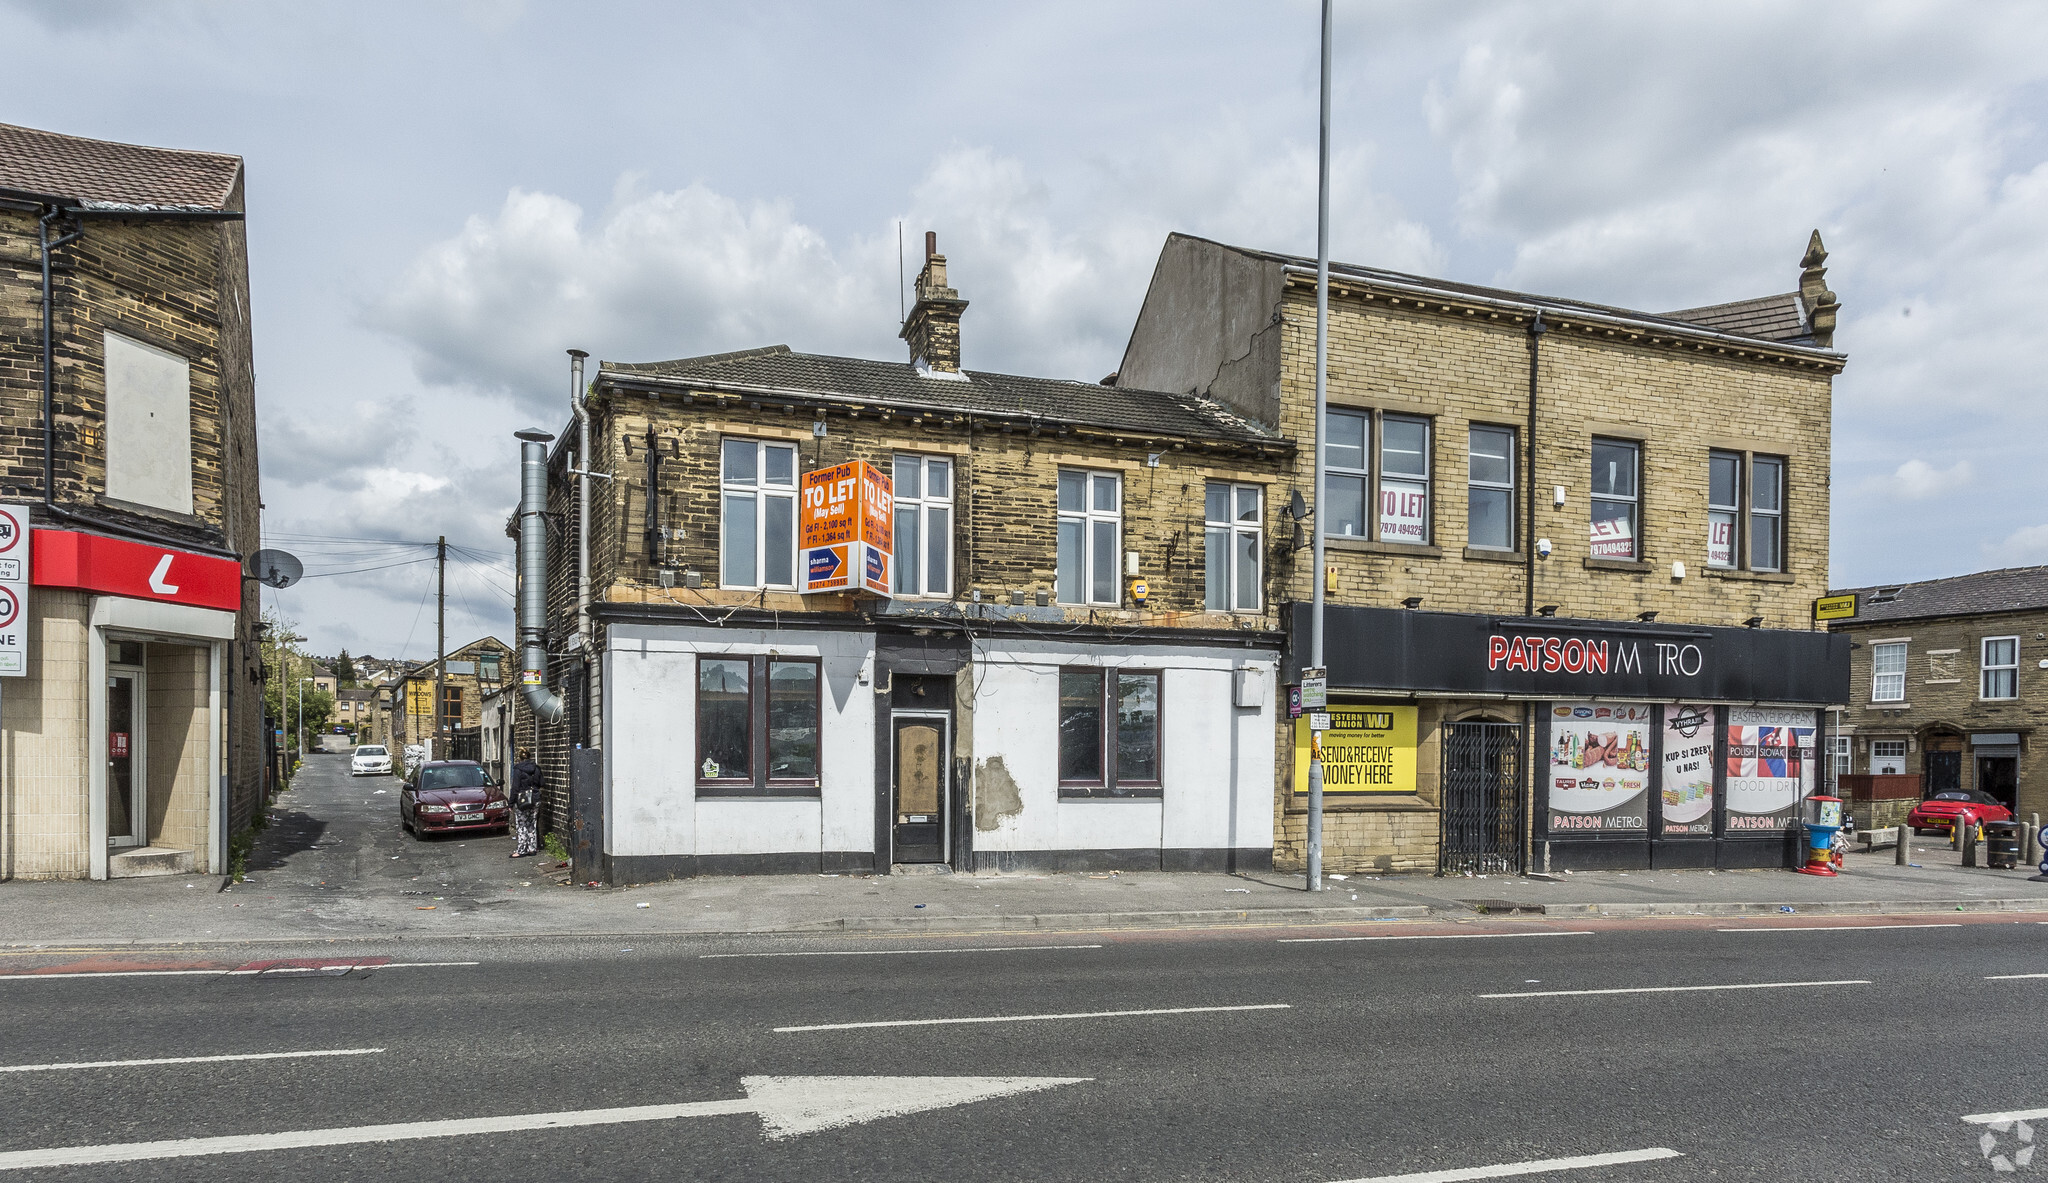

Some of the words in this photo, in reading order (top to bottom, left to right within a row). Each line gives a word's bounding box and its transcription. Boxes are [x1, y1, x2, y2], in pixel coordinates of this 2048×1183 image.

[810, 471, 834, 485] Former
[836, 465, 851, 479] Pub
[805, 485, 824, 509] TO
[828, 477, 856, 504] LET
[863, 477, 875, 505] TO
[877, 486, 892, 514] LET
[1380, 490, 1396, 516] TO
[1400, 492, 1425, 518] LET
[814, 507, 829, 520] (May
[829, 503, 845, 515] Sell)
[806, 524, 813, 533] Gd
[823, 519, 838, 531] 2,100
[839, 519, 847, 529] sq
[847, 517, 853, 526] ft
[1398, 523, 1423, 536] 494325
[822, 531, 836, 543] 1,364
[837, 532, 845, 542] sq
[845, 529, 851, 538] ft
[1712, 522, 1733, 546] LET
[810, 557, 829, 565] sharma
[810, 564, 834, 574] williamson
[1488, 635, 1609, 675] PATSON
[1331, 712, 1362, 720] ESTERN
[1367, 713, 1390, 729] WU
[1335, 720, 1363, 728] UNION
[1732, 711, 1768, 722] EASTERN
[1769, 712, 1812, 724] EUROPEAN
[1665, 751, 1680, 762] KUP
[1681, 749, 1689, 759] SI
[1690, 744, 1711, 757] ZREBY
[1730, 748, 1755, 756] POLISH
[1760, 749, 1785, 757] SLOVAK
[1790, 749, 1813, 758] CZCH
[1321, 764, 1363, 784] MONEY
[1365, 764, 1393, 784] HERE
[1676, 765, 1681, 774] U
[1683, 761, 1700, 771] NAS!
[1733, 780, 1766, 792] FOOD
[1553, 815, 1602, 828] PATSON
[1605, 816, 1643, 828] METRO
[1730, 816, 1774, 828] PATSON
[1665, 825, 1689, 833] PATSON
[1689, 825, 1708, 833] METRO
